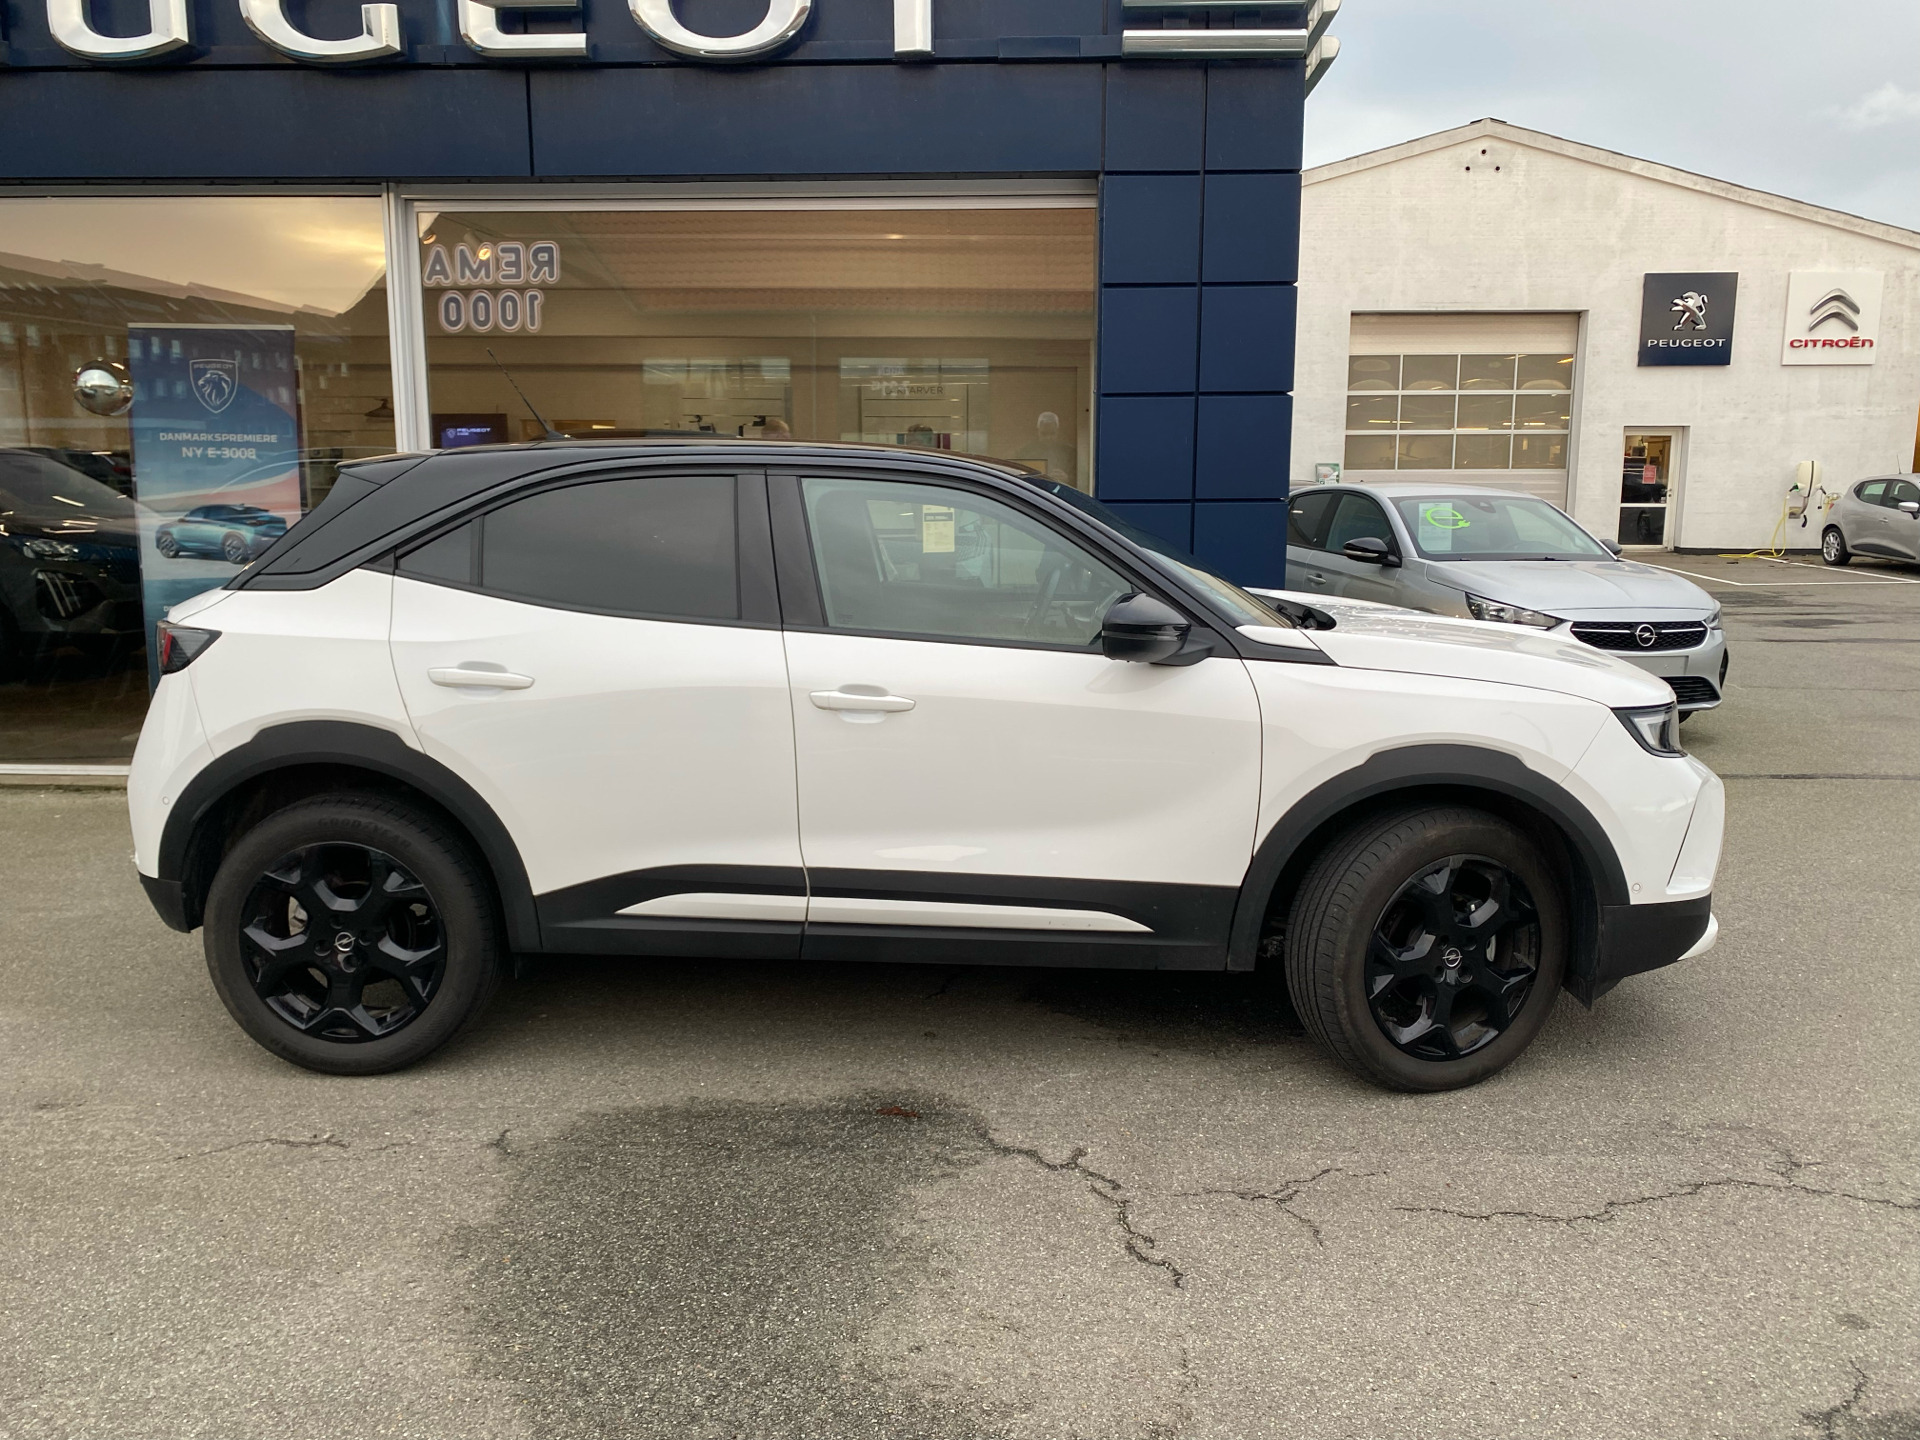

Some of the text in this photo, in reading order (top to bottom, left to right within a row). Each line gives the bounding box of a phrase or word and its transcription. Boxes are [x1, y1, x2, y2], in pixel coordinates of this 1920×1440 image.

[1647, 338, 1726, 348] PEUGEOT
[159, 432, 277, 443] DANMARKSPREMIERE
[181, 447, 256, 459] NY E-3008
